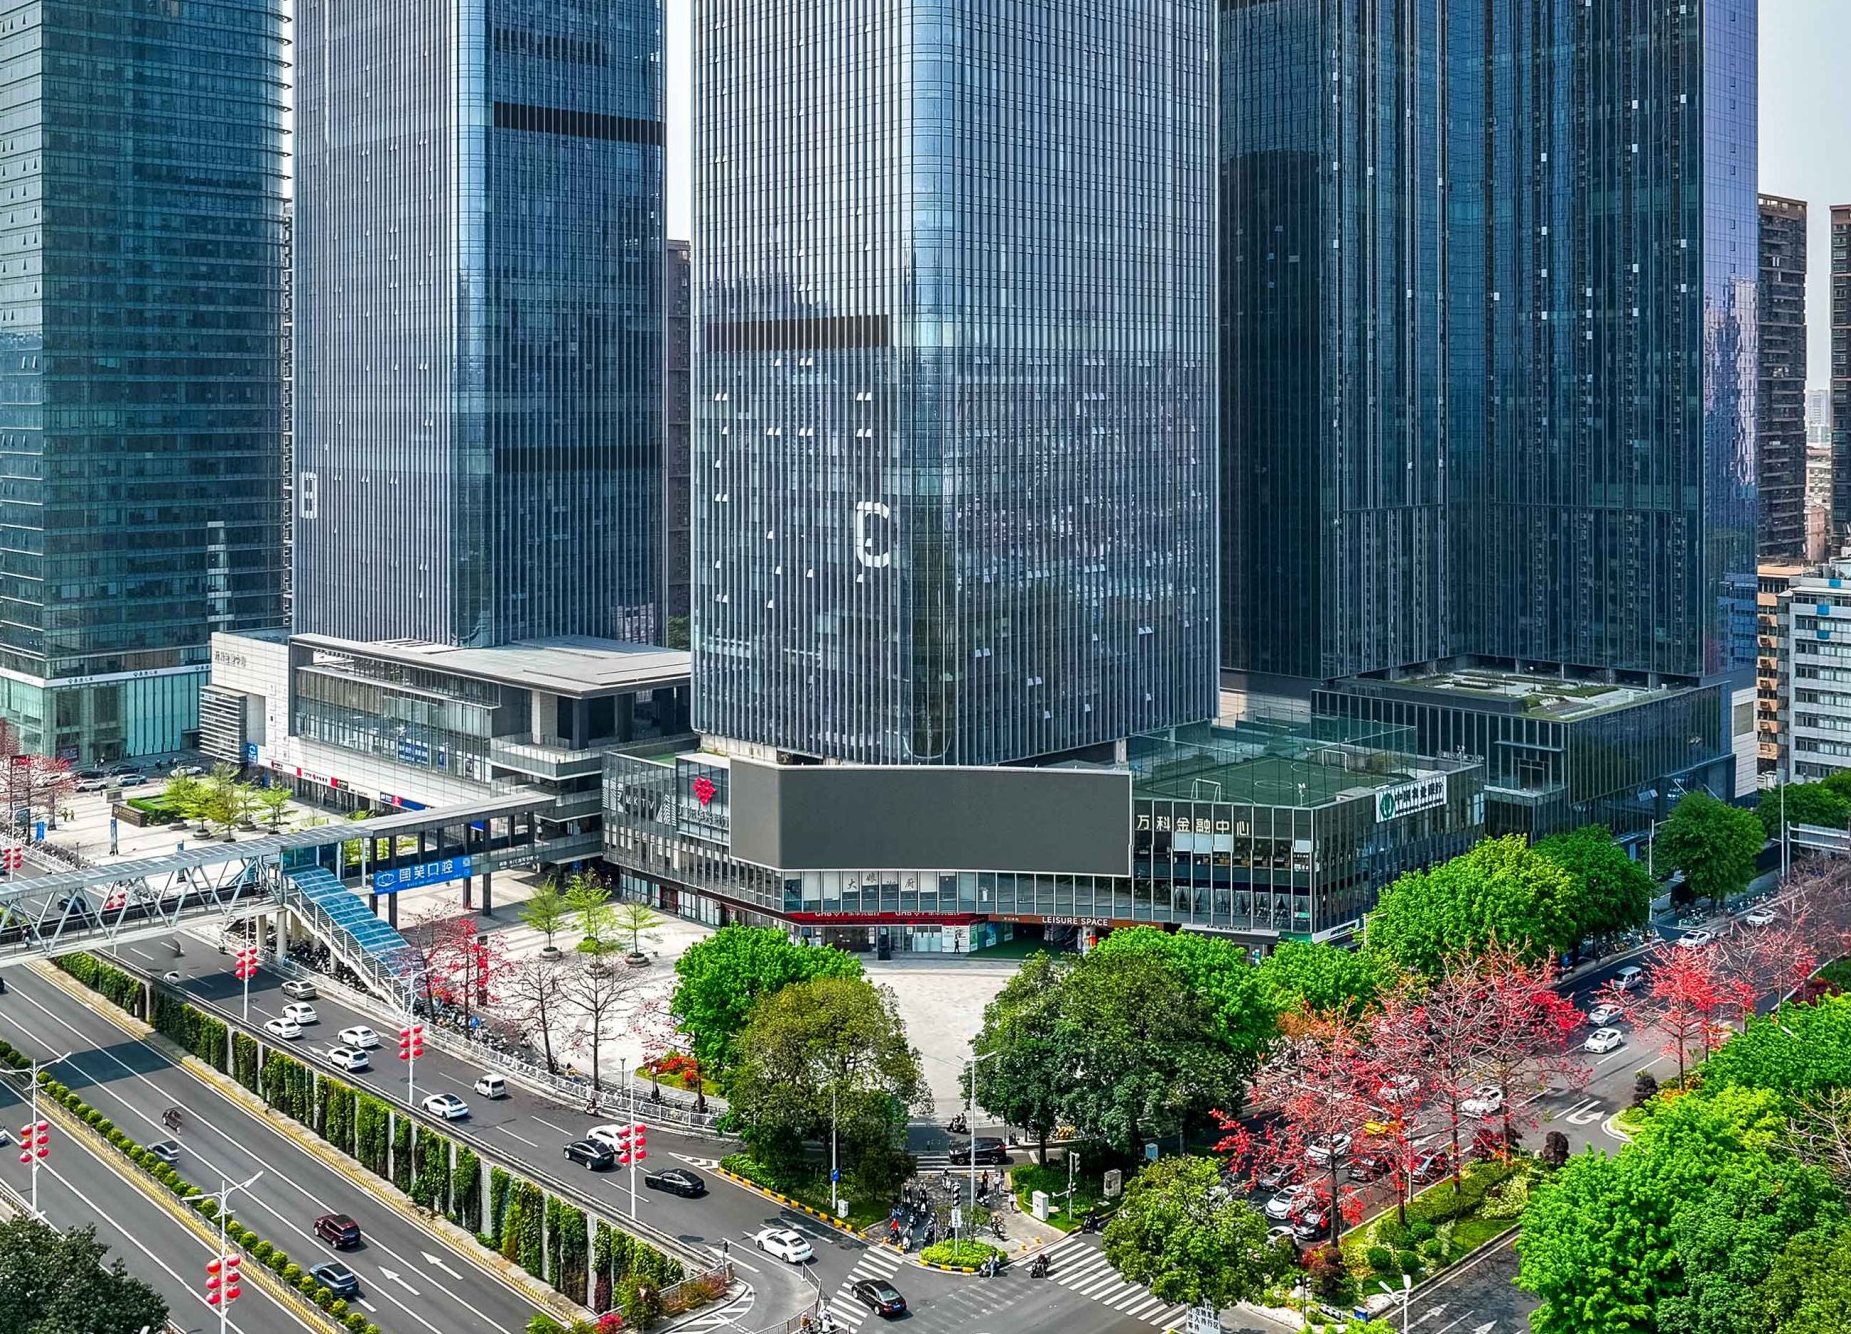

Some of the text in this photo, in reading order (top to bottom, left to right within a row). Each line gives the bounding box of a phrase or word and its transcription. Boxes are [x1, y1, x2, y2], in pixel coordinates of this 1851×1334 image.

[1136, 814, 1249, 837] 万科金融中心
[1042, 916, 1108, 926] LEISURE SPACE
